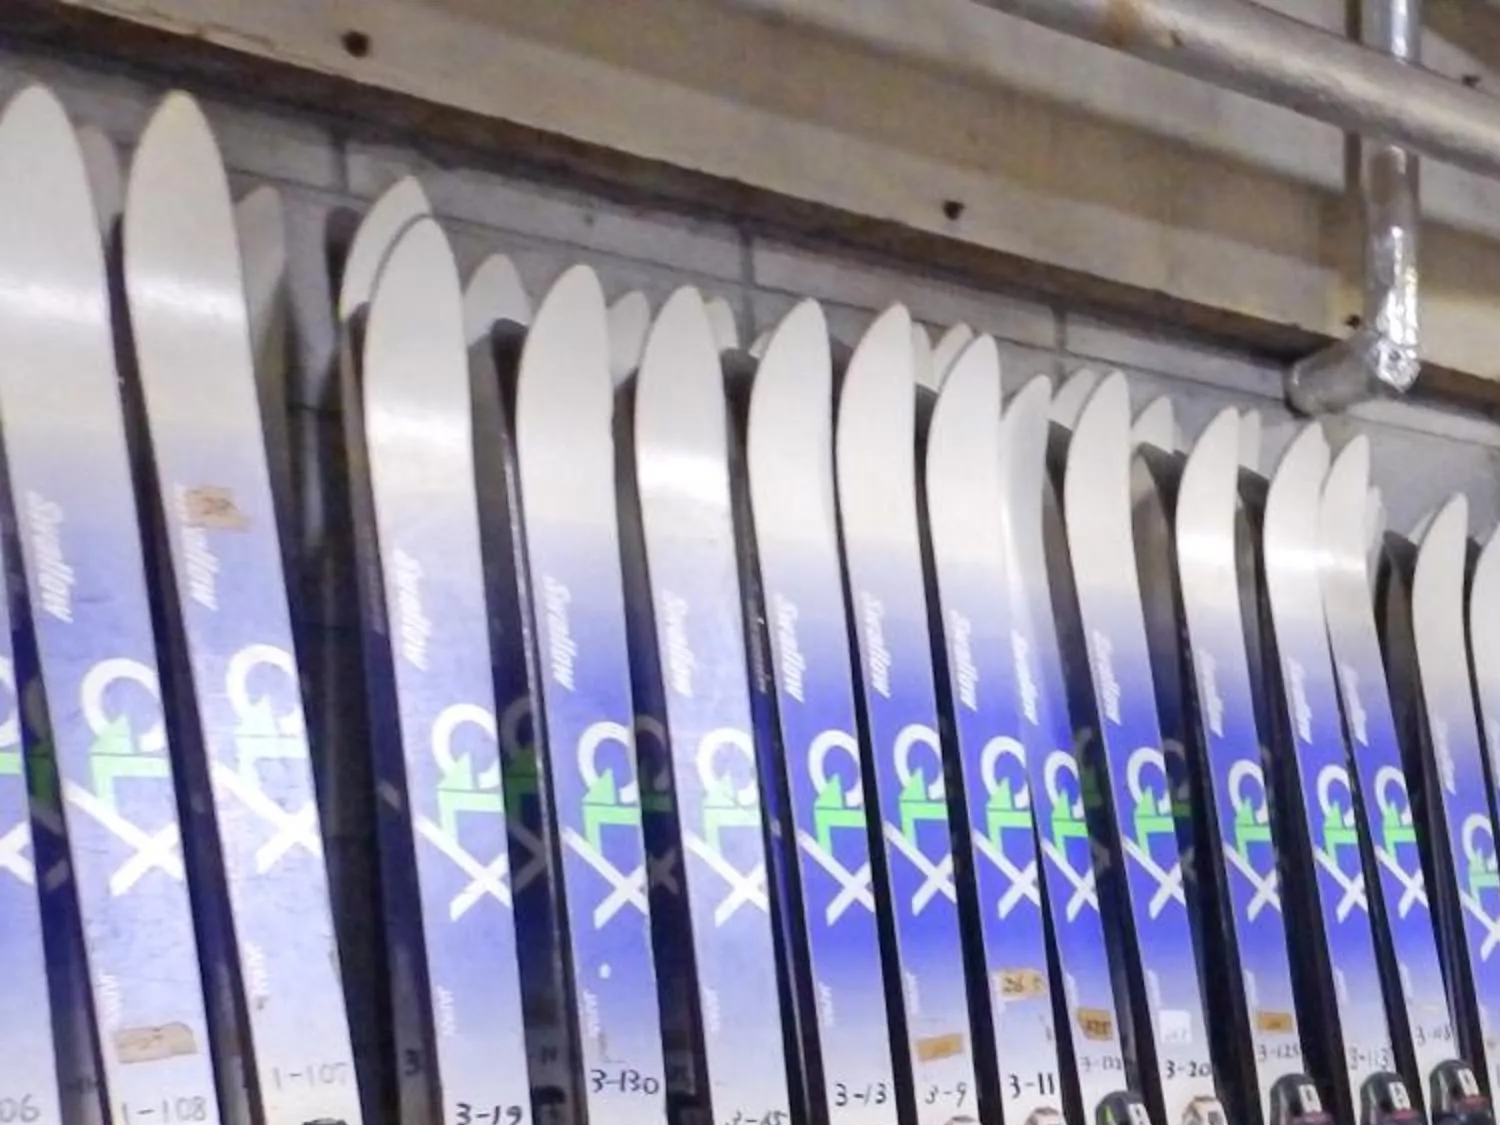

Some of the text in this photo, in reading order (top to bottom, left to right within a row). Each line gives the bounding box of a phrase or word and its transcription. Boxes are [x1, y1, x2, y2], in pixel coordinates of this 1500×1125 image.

[175, 483, 219, 611] allow
[1166, 1060, 1211, 1079] 3-20
[835, 1081, 888, 1107] 3-13
[1009, 1072, 1055, 1099] 3-11
